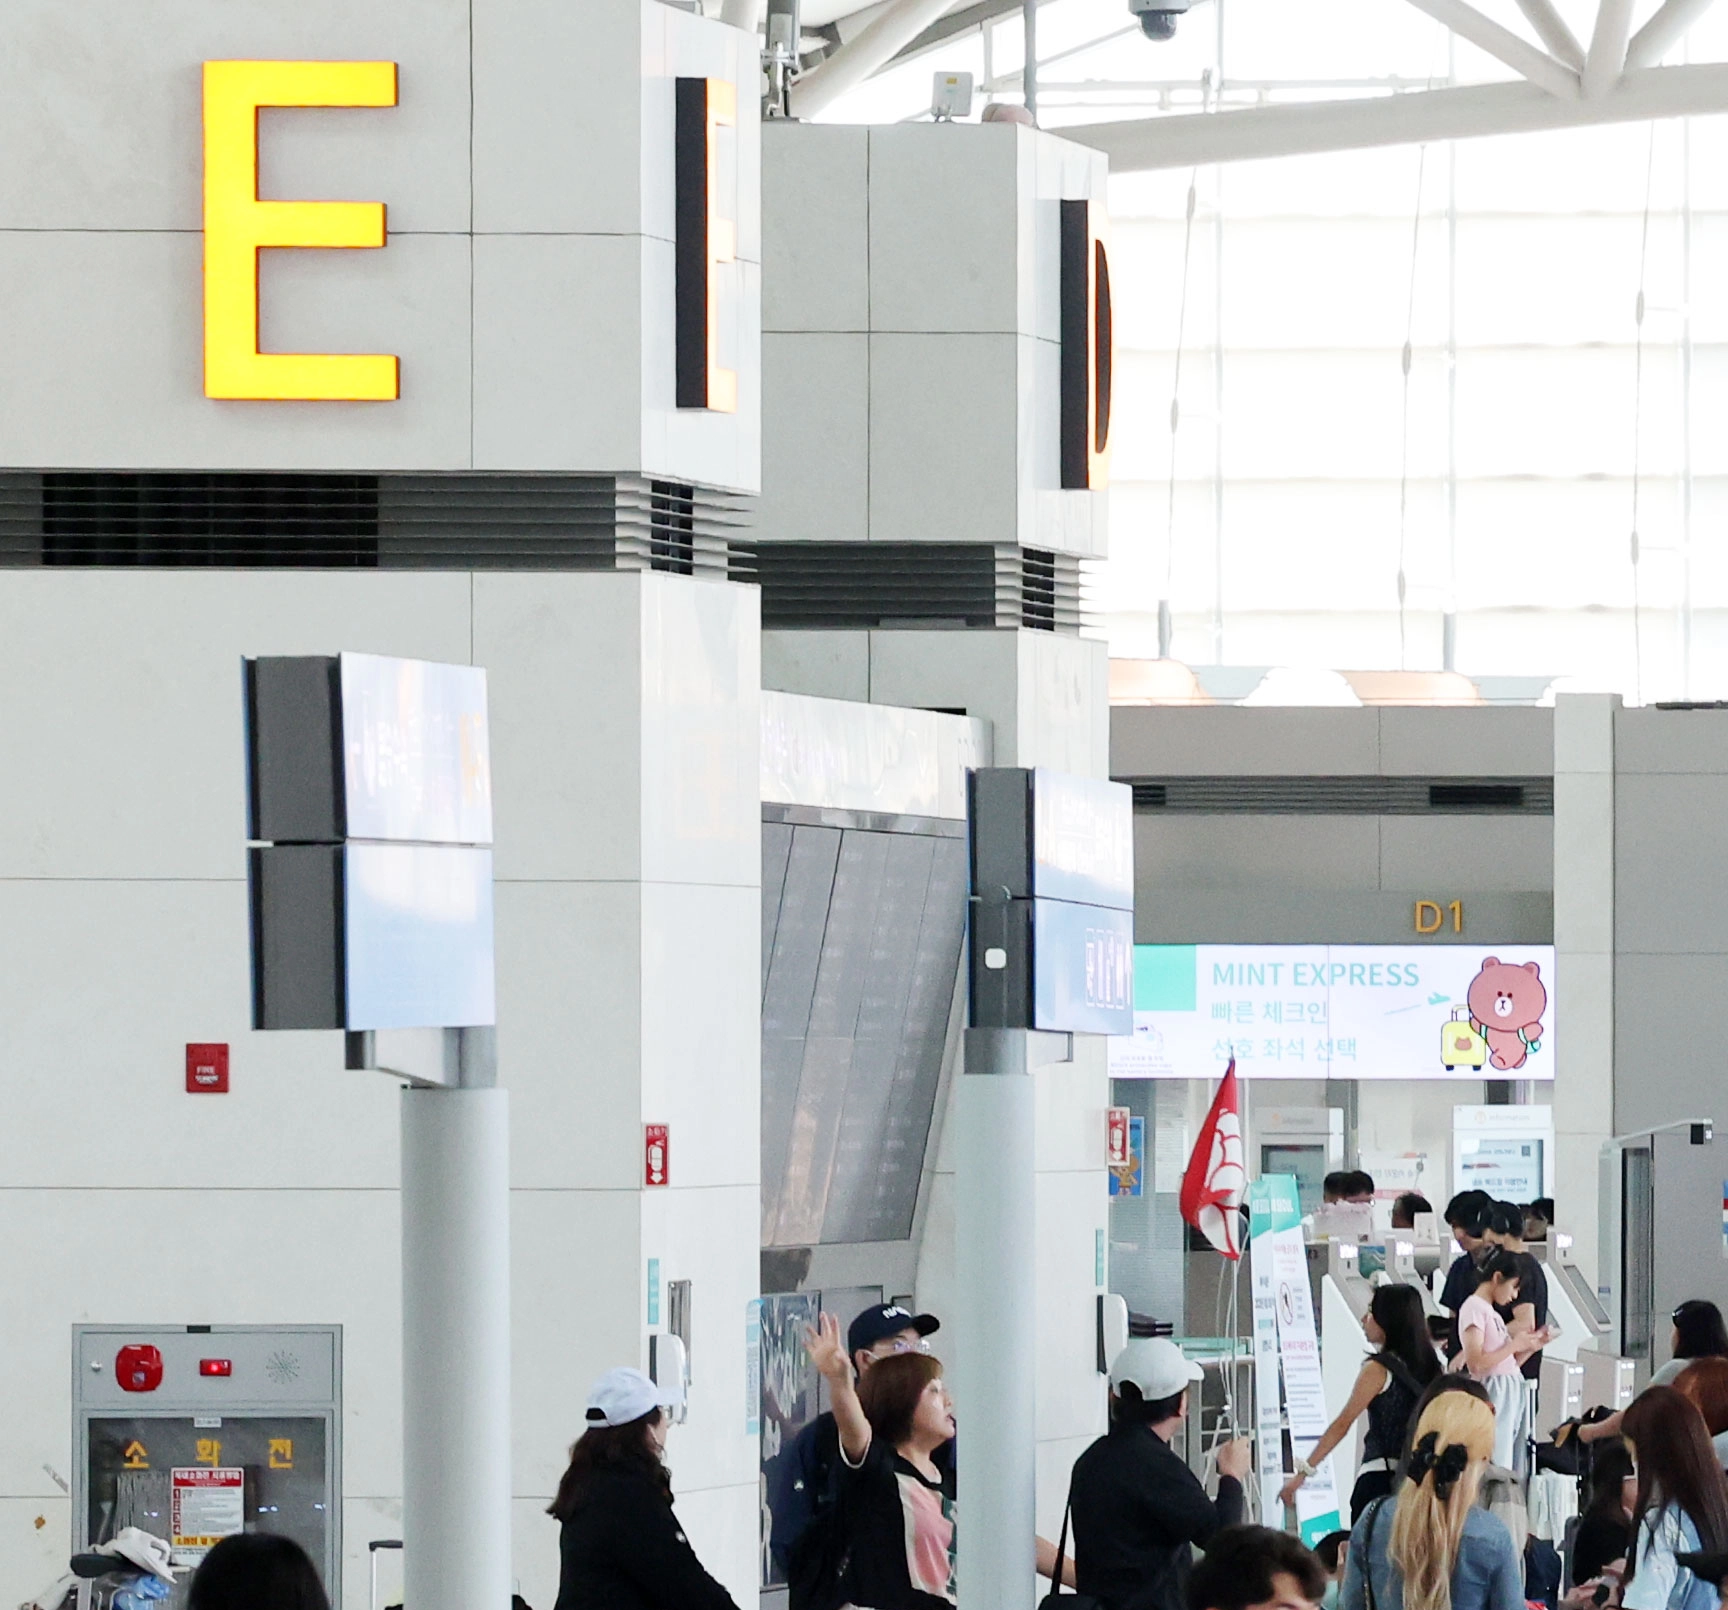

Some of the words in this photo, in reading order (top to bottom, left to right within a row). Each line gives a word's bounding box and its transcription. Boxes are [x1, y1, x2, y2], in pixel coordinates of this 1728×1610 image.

[203, 60, 400, 400] E
[1414, 900, 1464, 934] D1
[1212, 962, 1284, 987] MINT
[1292, 962, 1420, 988] EXPRESS
[1210, 1000, 1255, 1025] 빠른
[1262, 1000, 1328, 1025] 체크인
[1262, 1037, 1305, 1062] 좌석
[1313, 1037, 1358, 1062] 선택
